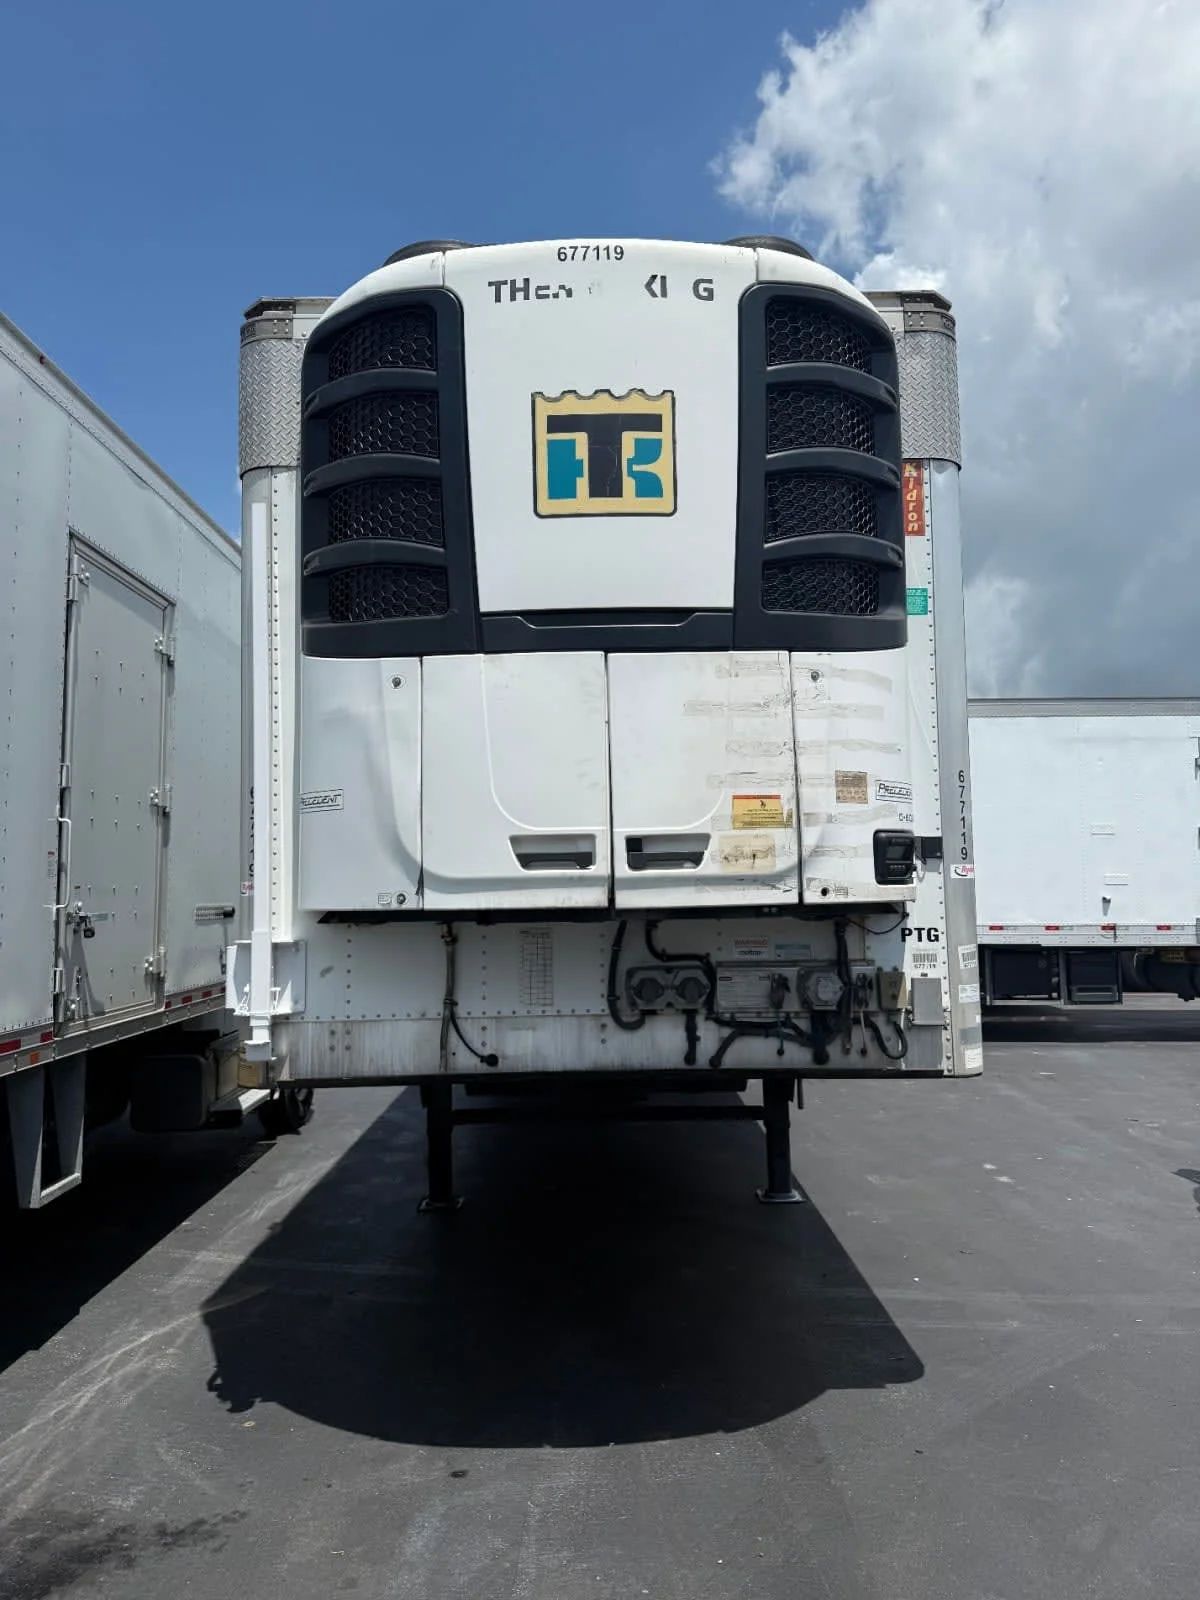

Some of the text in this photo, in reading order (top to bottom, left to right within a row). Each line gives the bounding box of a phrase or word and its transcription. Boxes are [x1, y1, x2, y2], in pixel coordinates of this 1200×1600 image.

[557, 244, 624, 262] 677119
[957, 769, 969, 861] 677119
[901, 927, 940, 943] PTG
